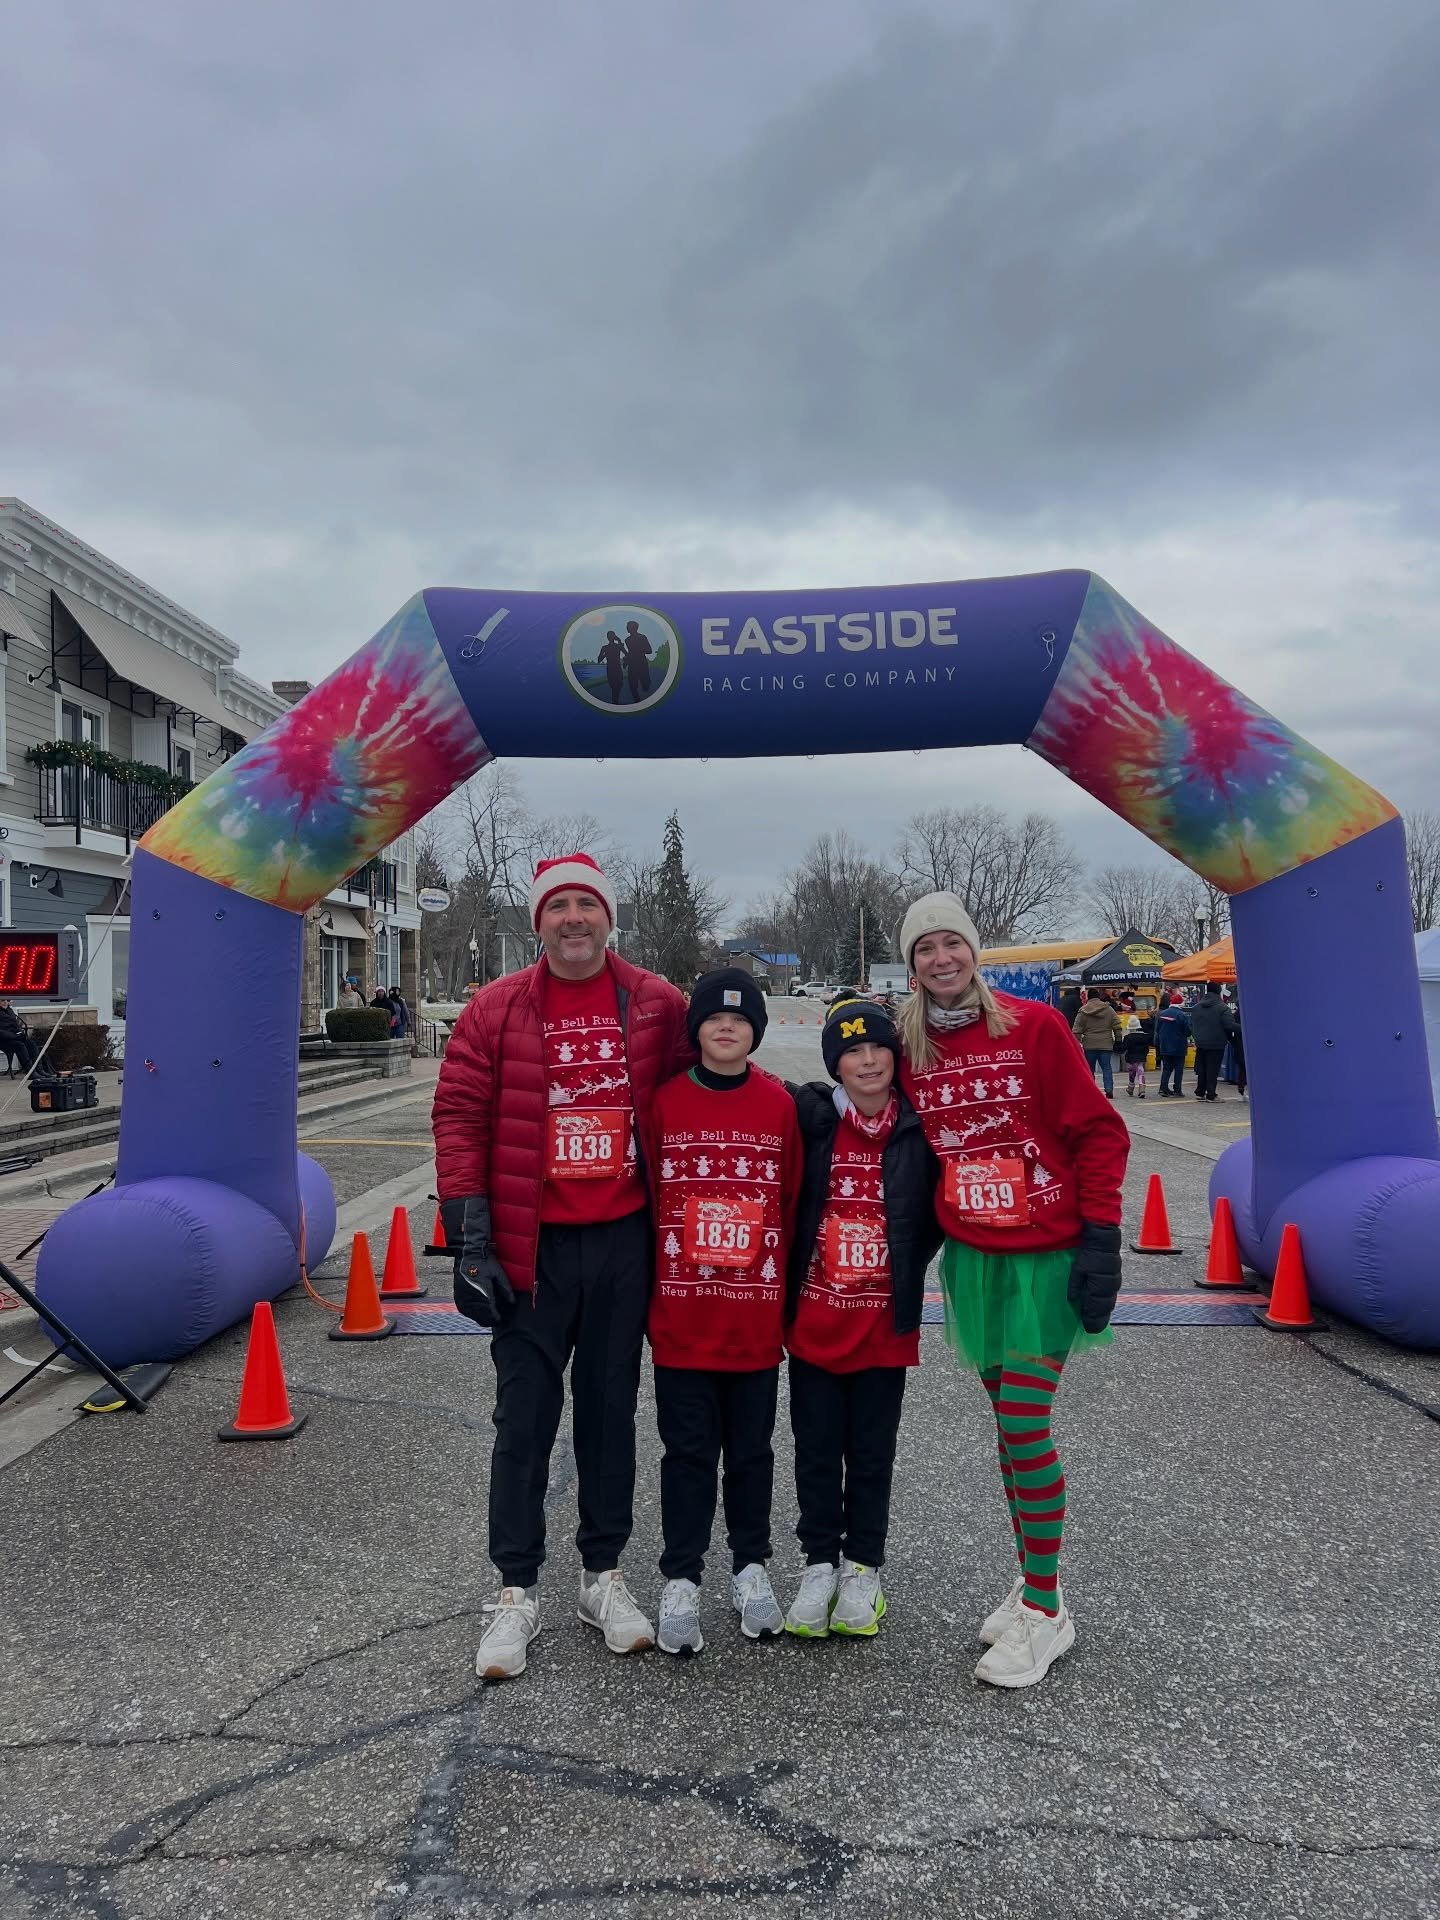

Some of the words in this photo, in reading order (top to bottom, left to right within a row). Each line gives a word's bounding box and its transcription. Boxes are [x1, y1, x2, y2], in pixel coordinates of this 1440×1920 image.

[702, 608, 958, 655] EASTSIDE
[703, 675, 805, 692] RACING
[825, 667, 956, 688] COMPANY
[1092, 973, 1126, 981] ANCHOR
[561, 1017, 586, 1029] Bell
[592, 1016, 617, 1026] Run
[840, 1017, 866, 1038] M
[944, 1057, 963, 1069] Bell
[967, 1055, 991, 1065] Run
[995, 1050, 1023, 1061] 2025
[663, 1132, 694, 1143] ingle
[700, 1131, 725, 1140] Bell
[732, 1131, 756, 1142] Run
[555, 1134, 612, 1160] 1838
[847, 1152, 871, 1162] Bell
[957, 1183, 1014, 1210] 1839
[1042, 1190, 1061, 1205] MI
[696, 1221, 750, 1249] 1836
[838, 1242, 889, 1267] 1837
[661, 1286, 688, 1297] New
[695, 1286, 755, 1300] Baltimore,
[762, 1290, 779, 1300] MI
[828, 1296, 888, 1308] Baltimore
